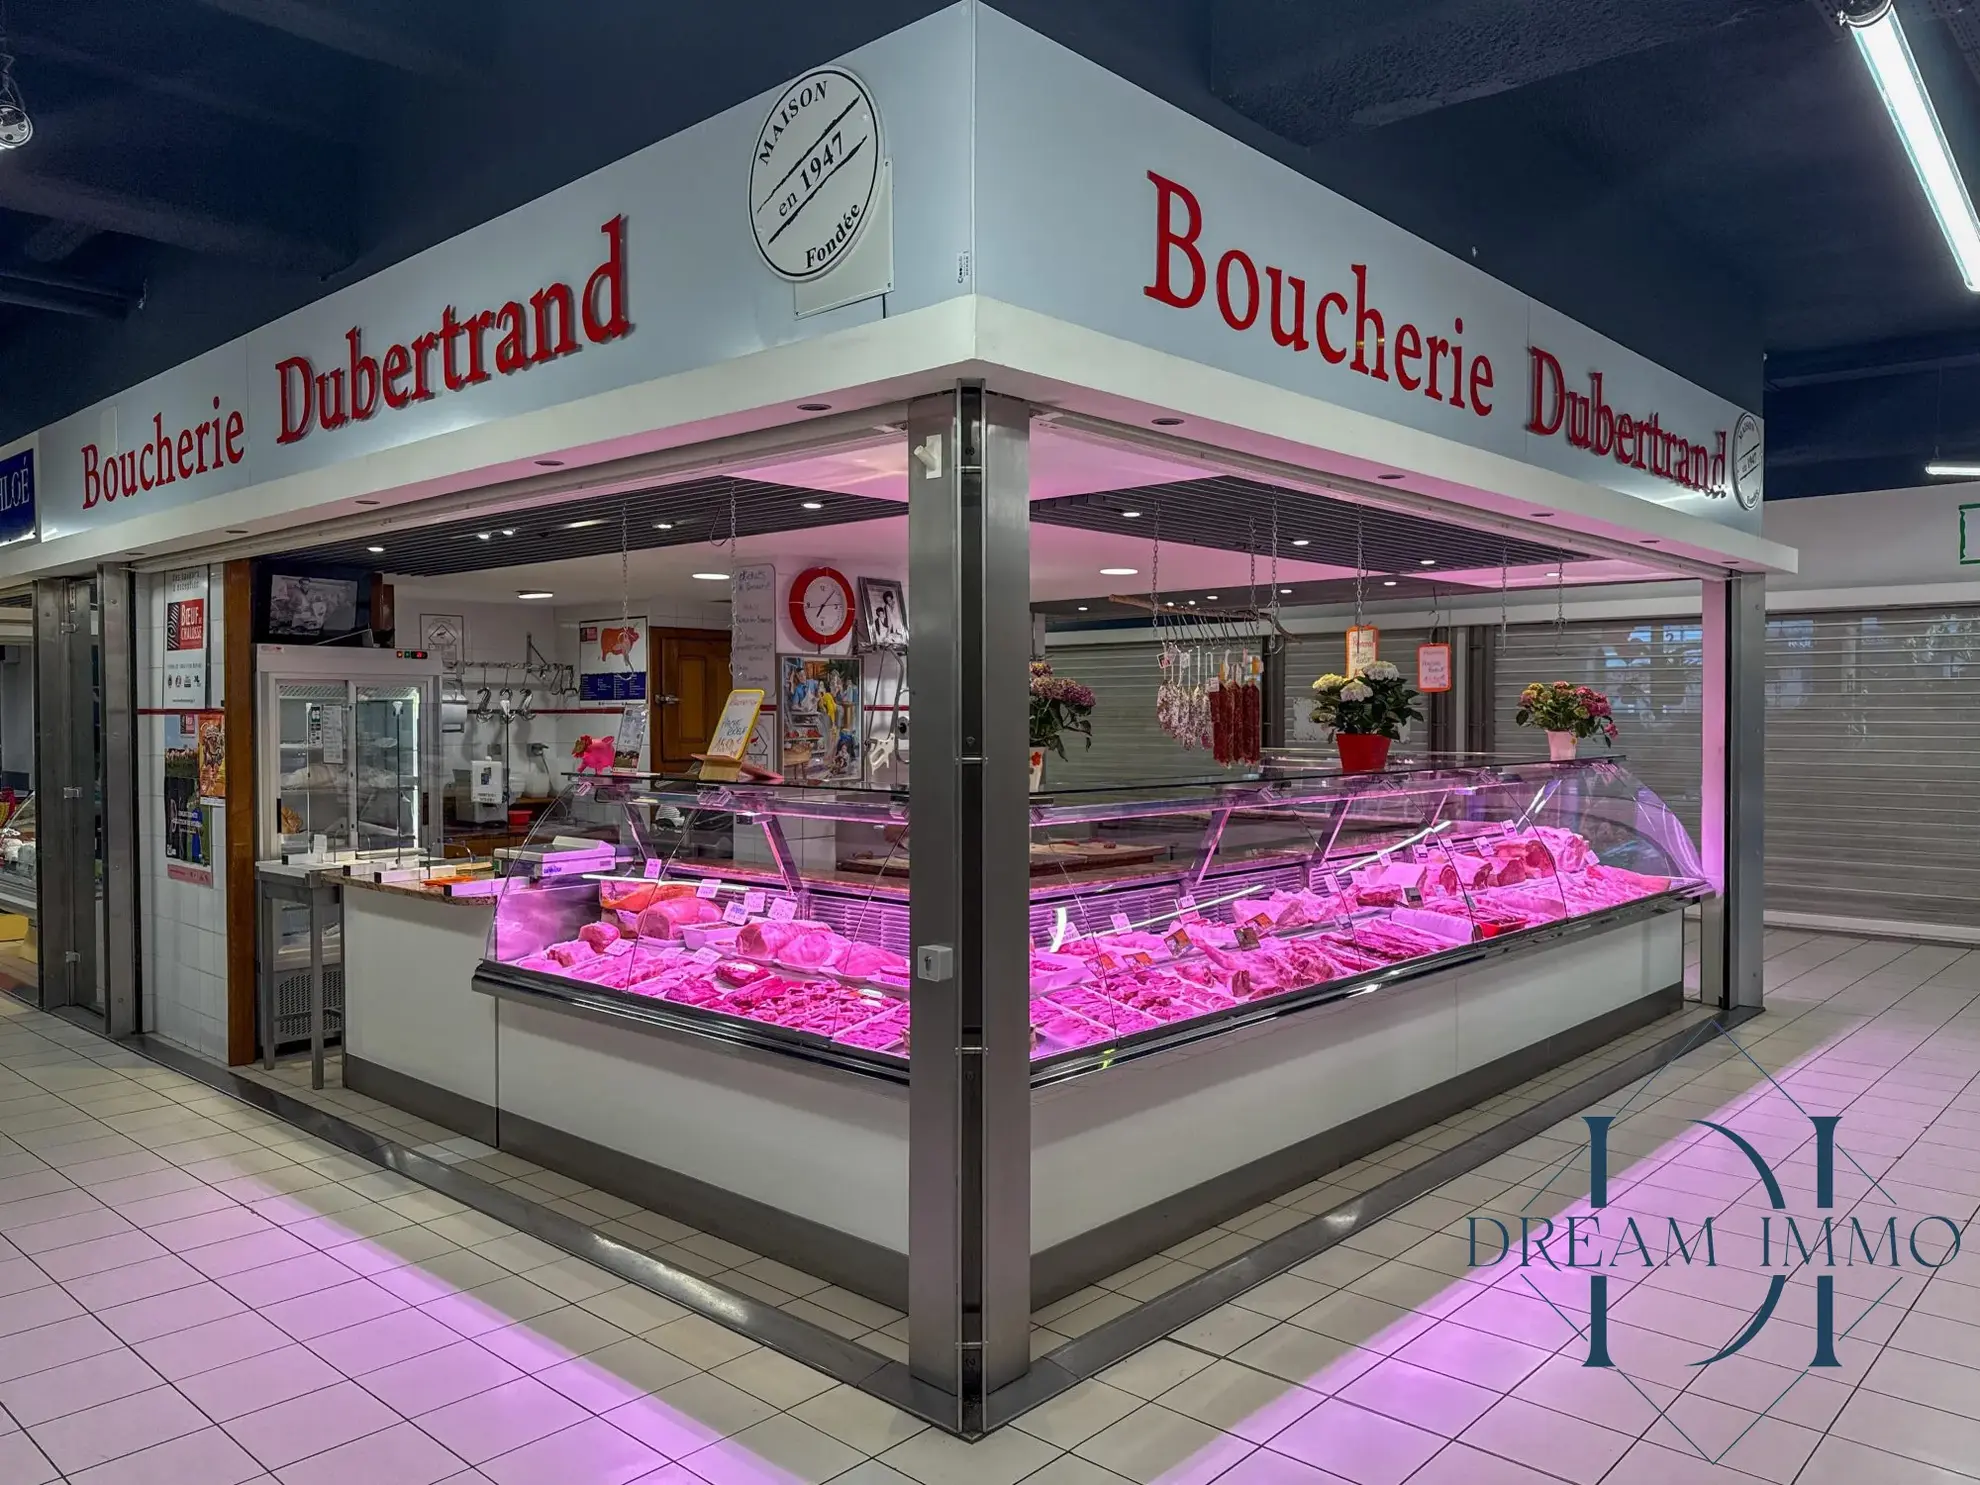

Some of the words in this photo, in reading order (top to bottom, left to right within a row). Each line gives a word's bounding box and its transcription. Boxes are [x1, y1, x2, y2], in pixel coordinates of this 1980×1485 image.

[757, 80, 828, 166] MAISON
[778, 192, 798, 218] en
[799, 130, 845, 192] 1947
[805, 203, 861, 270] Fondée
[82, 396, 244, 511] Boucherie
[275, 213, 634, 446] Dubertrand
[1143, 170, 1494, 417] Boucherie
[1528, 346, 1728, 498] Dubertrand
[180, 626, 202, 641] CHALOSSE
